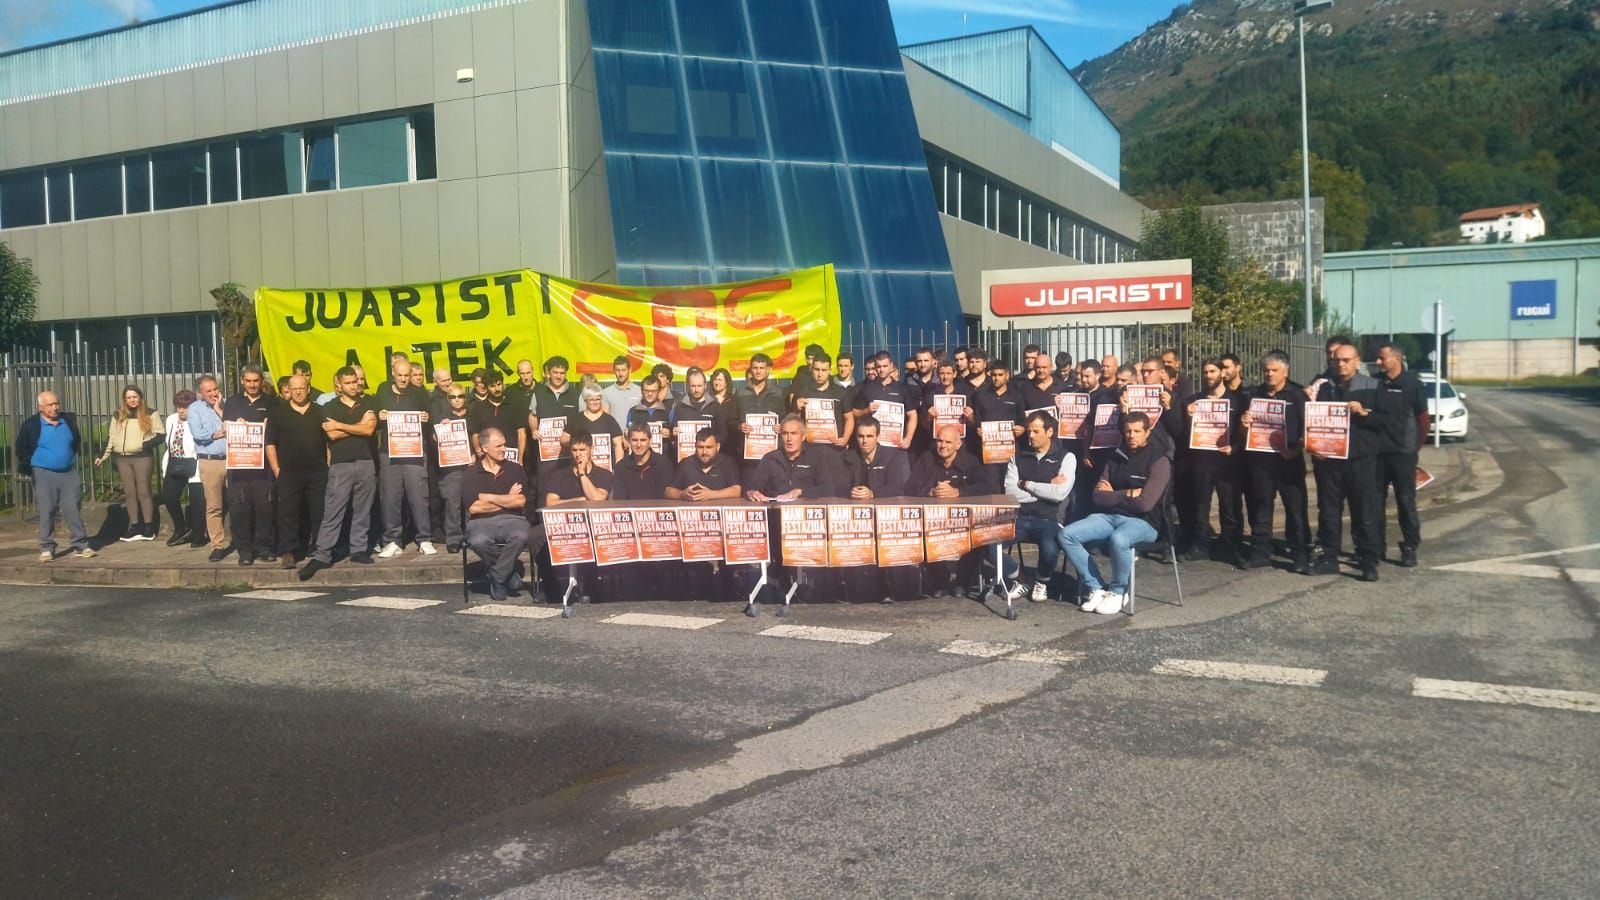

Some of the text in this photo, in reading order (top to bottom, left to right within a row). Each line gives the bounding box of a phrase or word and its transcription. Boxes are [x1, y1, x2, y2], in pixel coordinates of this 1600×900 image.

[1024, 282, 1182, 307] JUARISTI
[286, 273, 551, 332] JUARISTI
[571, 279, 799, 374] SOS
[545, 512, 584, 524] MANI 26
[591, 511, 630, 524] MANI 26
[635, 511, 674, 522] MANI 26
[680, 510, 718, 521] MANI 26
[725, 510, 764, 521] MANI 26
[783, 506, 823, 520] MANI 26
[829, 506, 871, 520] MANI 26
[879, 506, 919, 520] MANI 26
[925, 506, 968, 520] MANI 26
[547, 522, 588, 536] FESTAZIOA
[593, 522, 634, 535] FESTAZIOA
[638, 521, 678, 533] FESTAZIOA
[682, 521, 720, 532] FESTAZIOA
[727, 521, 766, 533] FESTAZIOA
[783, 520, 825, 533] FESTAZIOA
[831, 520, 873, 533] FESTAZIOA
[880, 520, 920, 532] FESTAZIOA
[926, 519, 970, 531] FESTAZIOA
